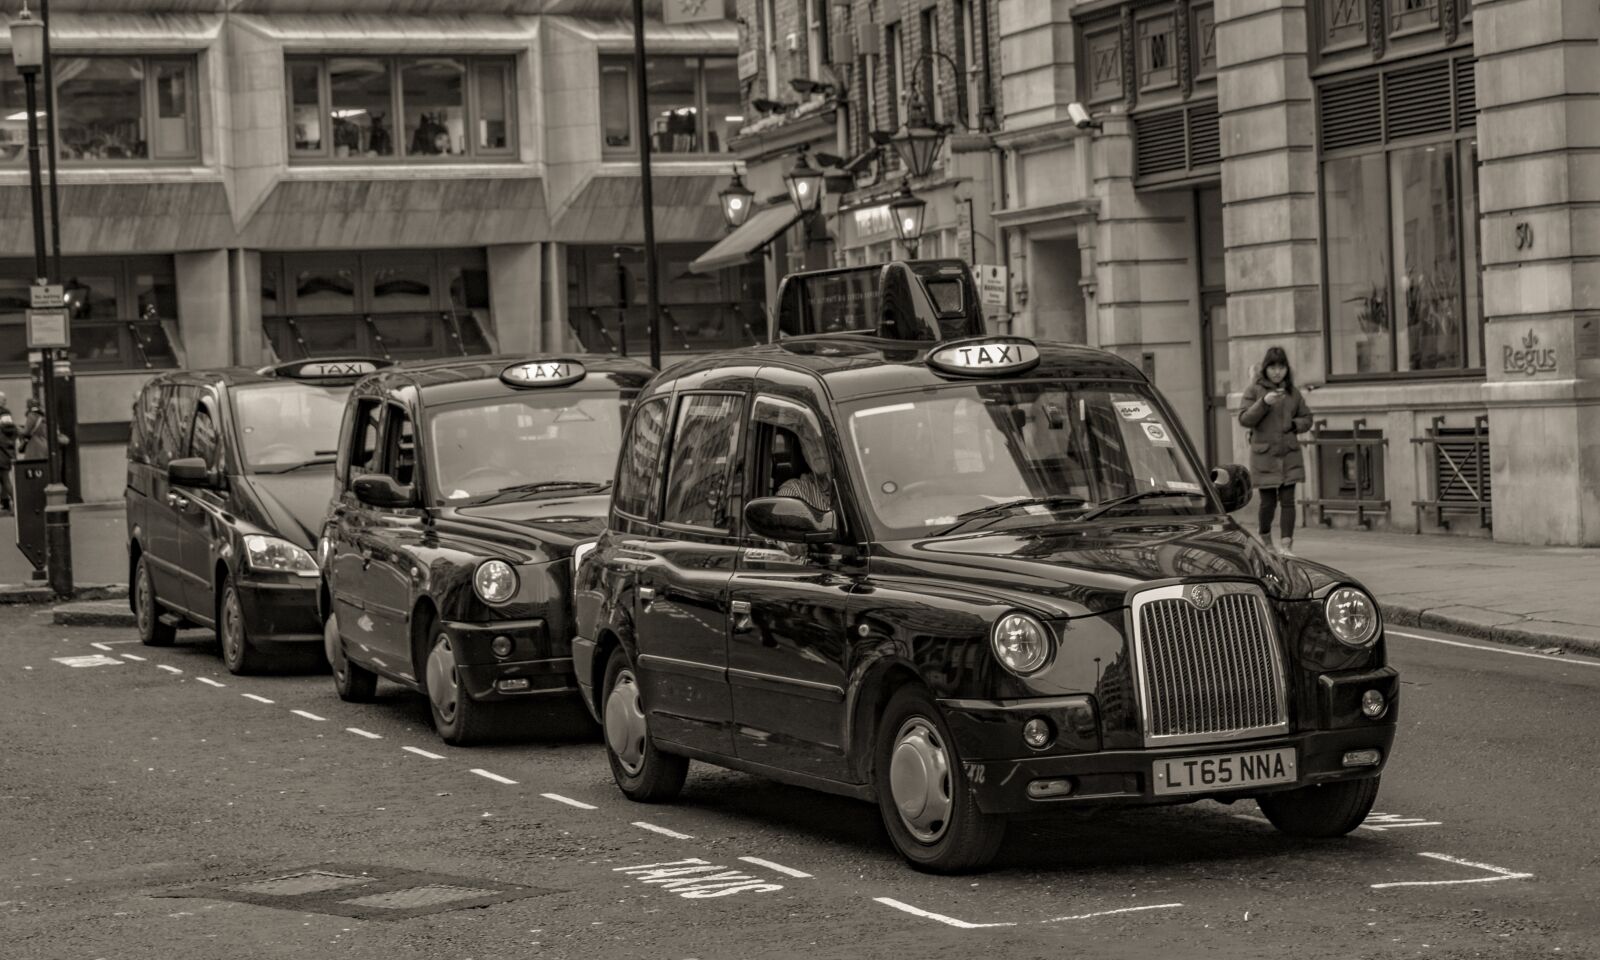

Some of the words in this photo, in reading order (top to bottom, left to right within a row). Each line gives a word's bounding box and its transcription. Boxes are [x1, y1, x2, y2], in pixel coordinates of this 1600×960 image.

[959, 346, 1022, 365] TAXI
[1503, 344, 1557, 376] Regus
[316, 363, 363, 375] TAXI
[521, 364, 570, 379] TAXI
[1165, 757, 1233, 788] LT65
[1240, 753, 1285, 781] NNA
[612, 857, 784, 899] TAXIS
